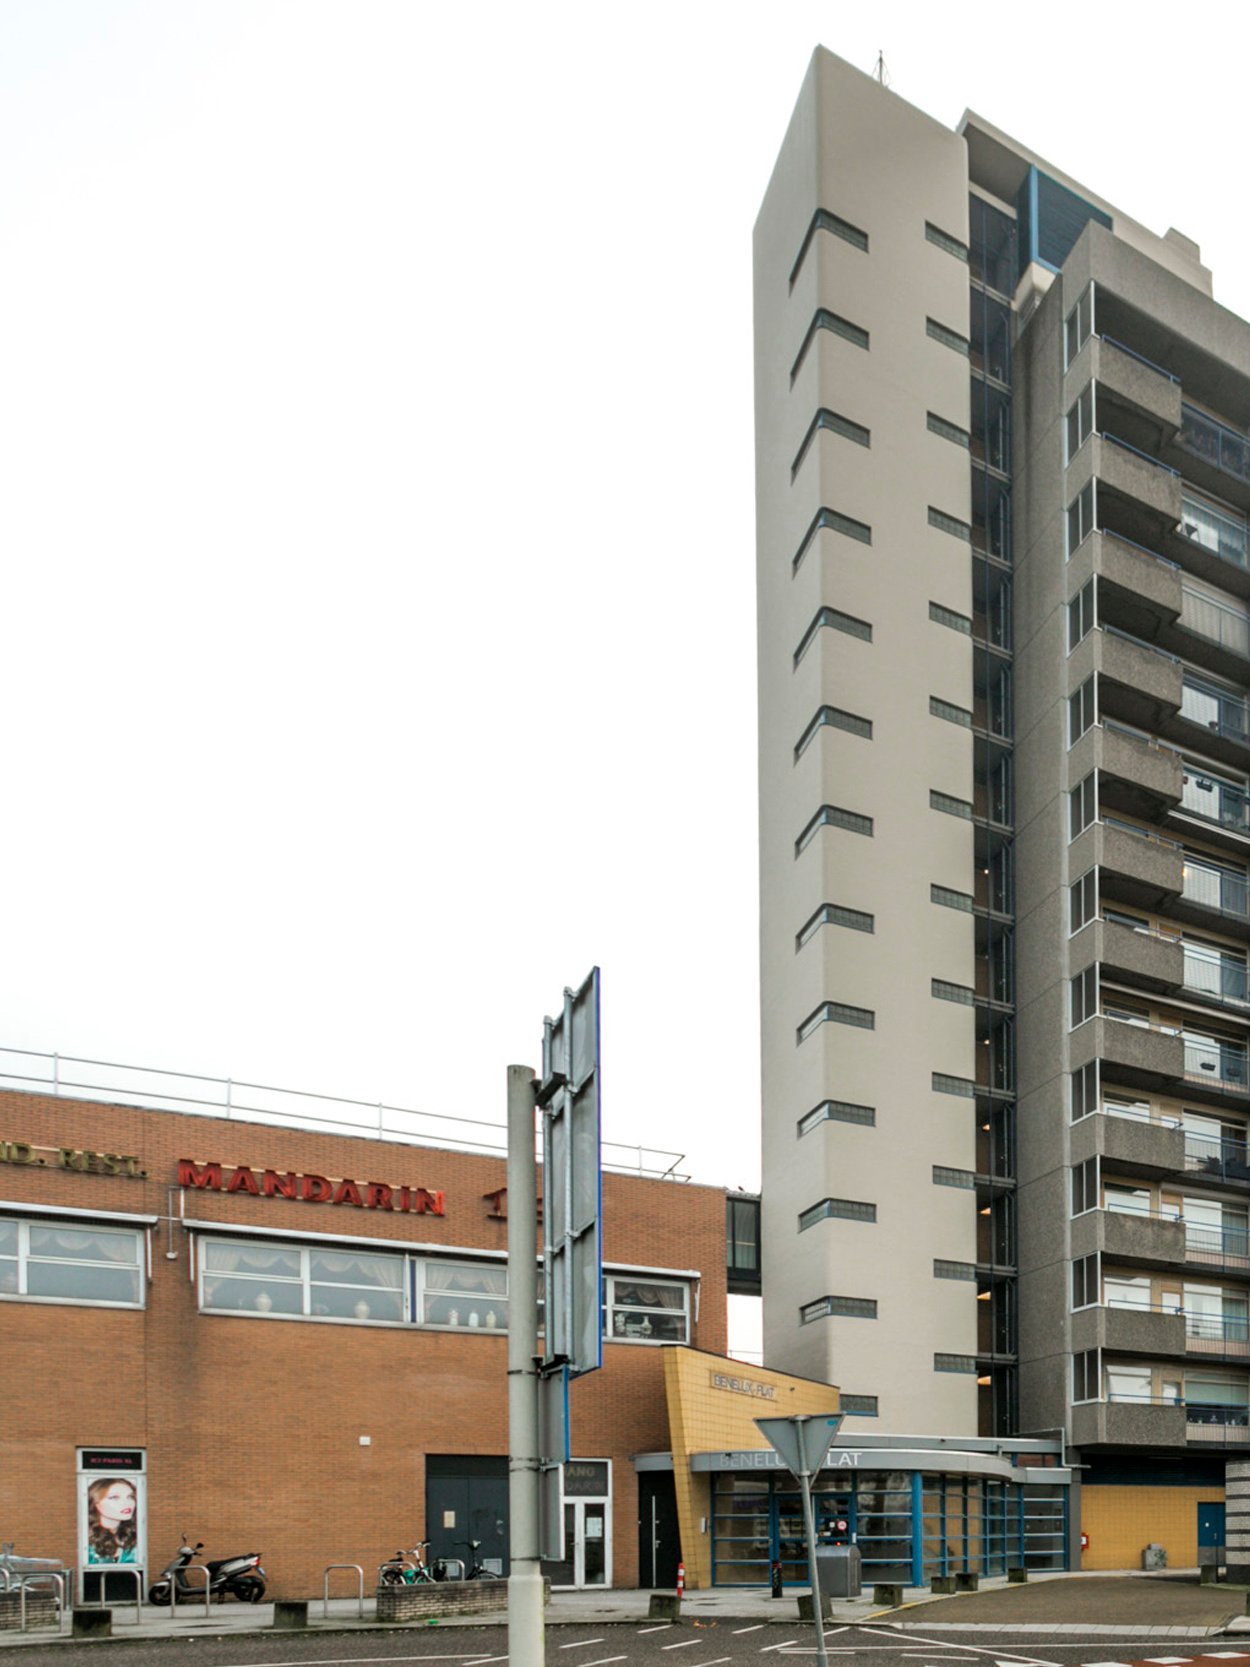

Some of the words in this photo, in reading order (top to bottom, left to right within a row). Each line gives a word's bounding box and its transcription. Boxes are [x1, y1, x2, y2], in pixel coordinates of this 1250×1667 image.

[59, 1148, 149, 1178] REST.
[178, 1159, 446, 1217] MANDARIN
[719, 1453, 787, 1467] BENELU
[827, 1452, 863, 1466] LAT
